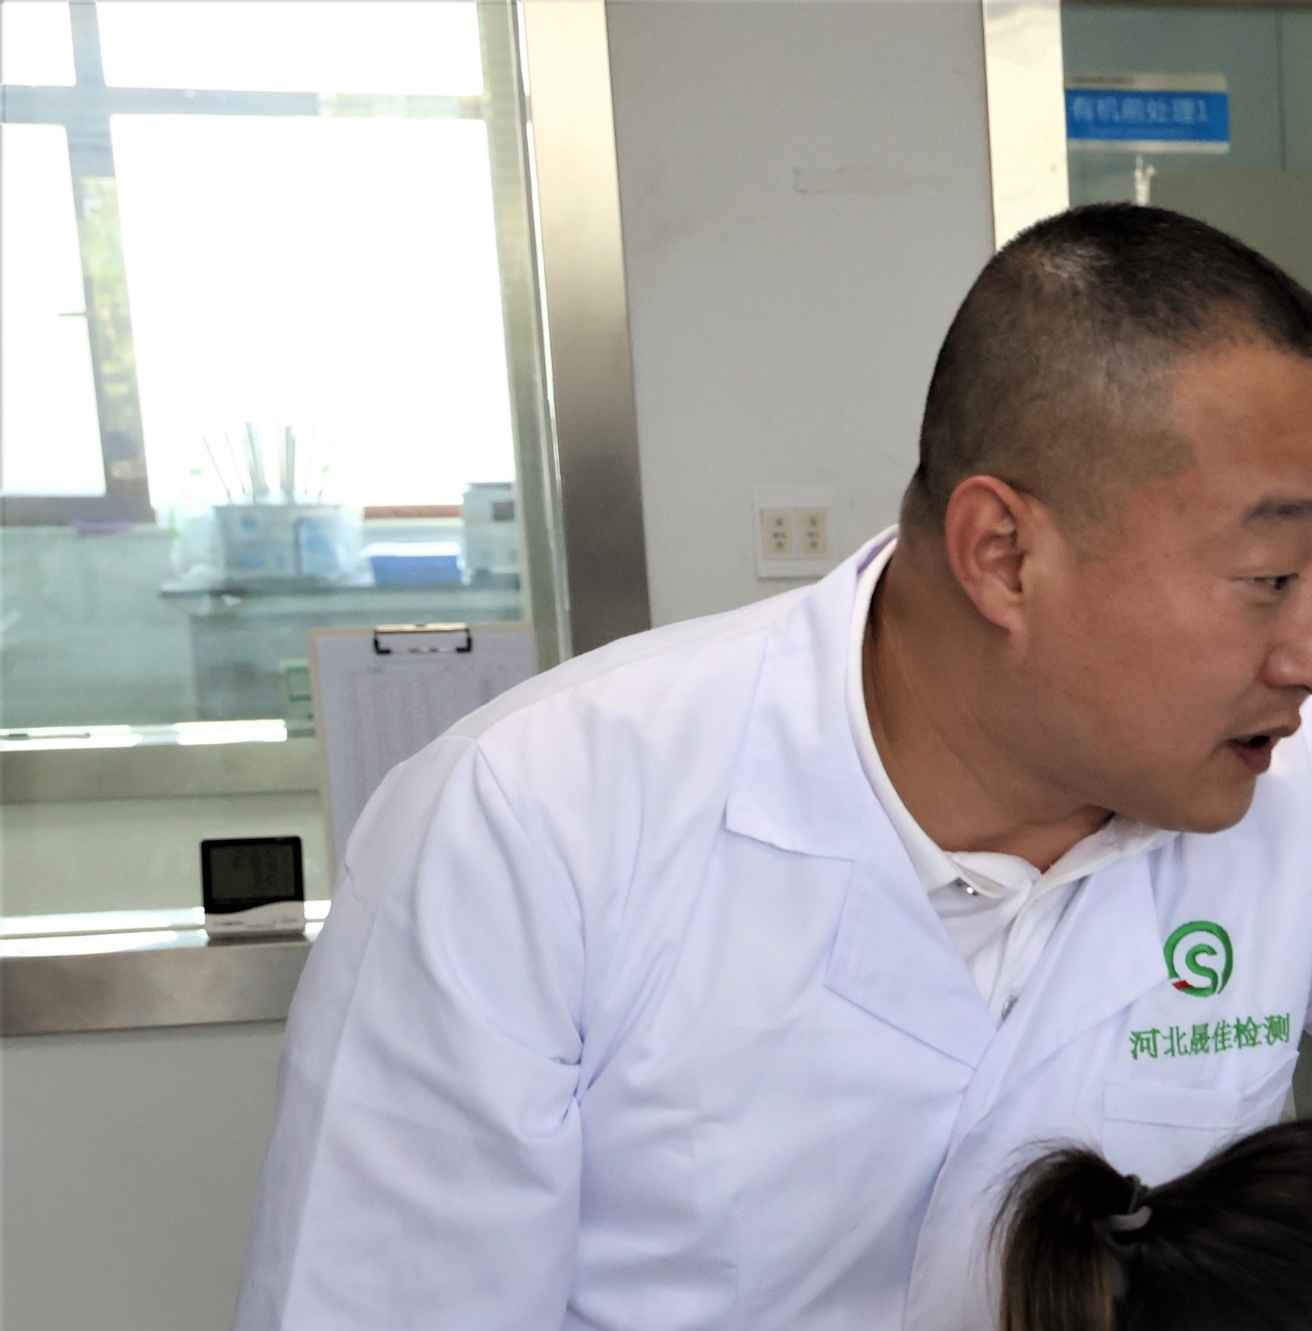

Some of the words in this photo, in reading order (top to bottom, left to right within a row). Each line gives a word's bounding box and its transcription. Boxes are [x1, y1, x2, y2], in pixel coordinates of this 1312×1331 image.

[1129, 1013, 1290, 1060] 河北晟佳检测
